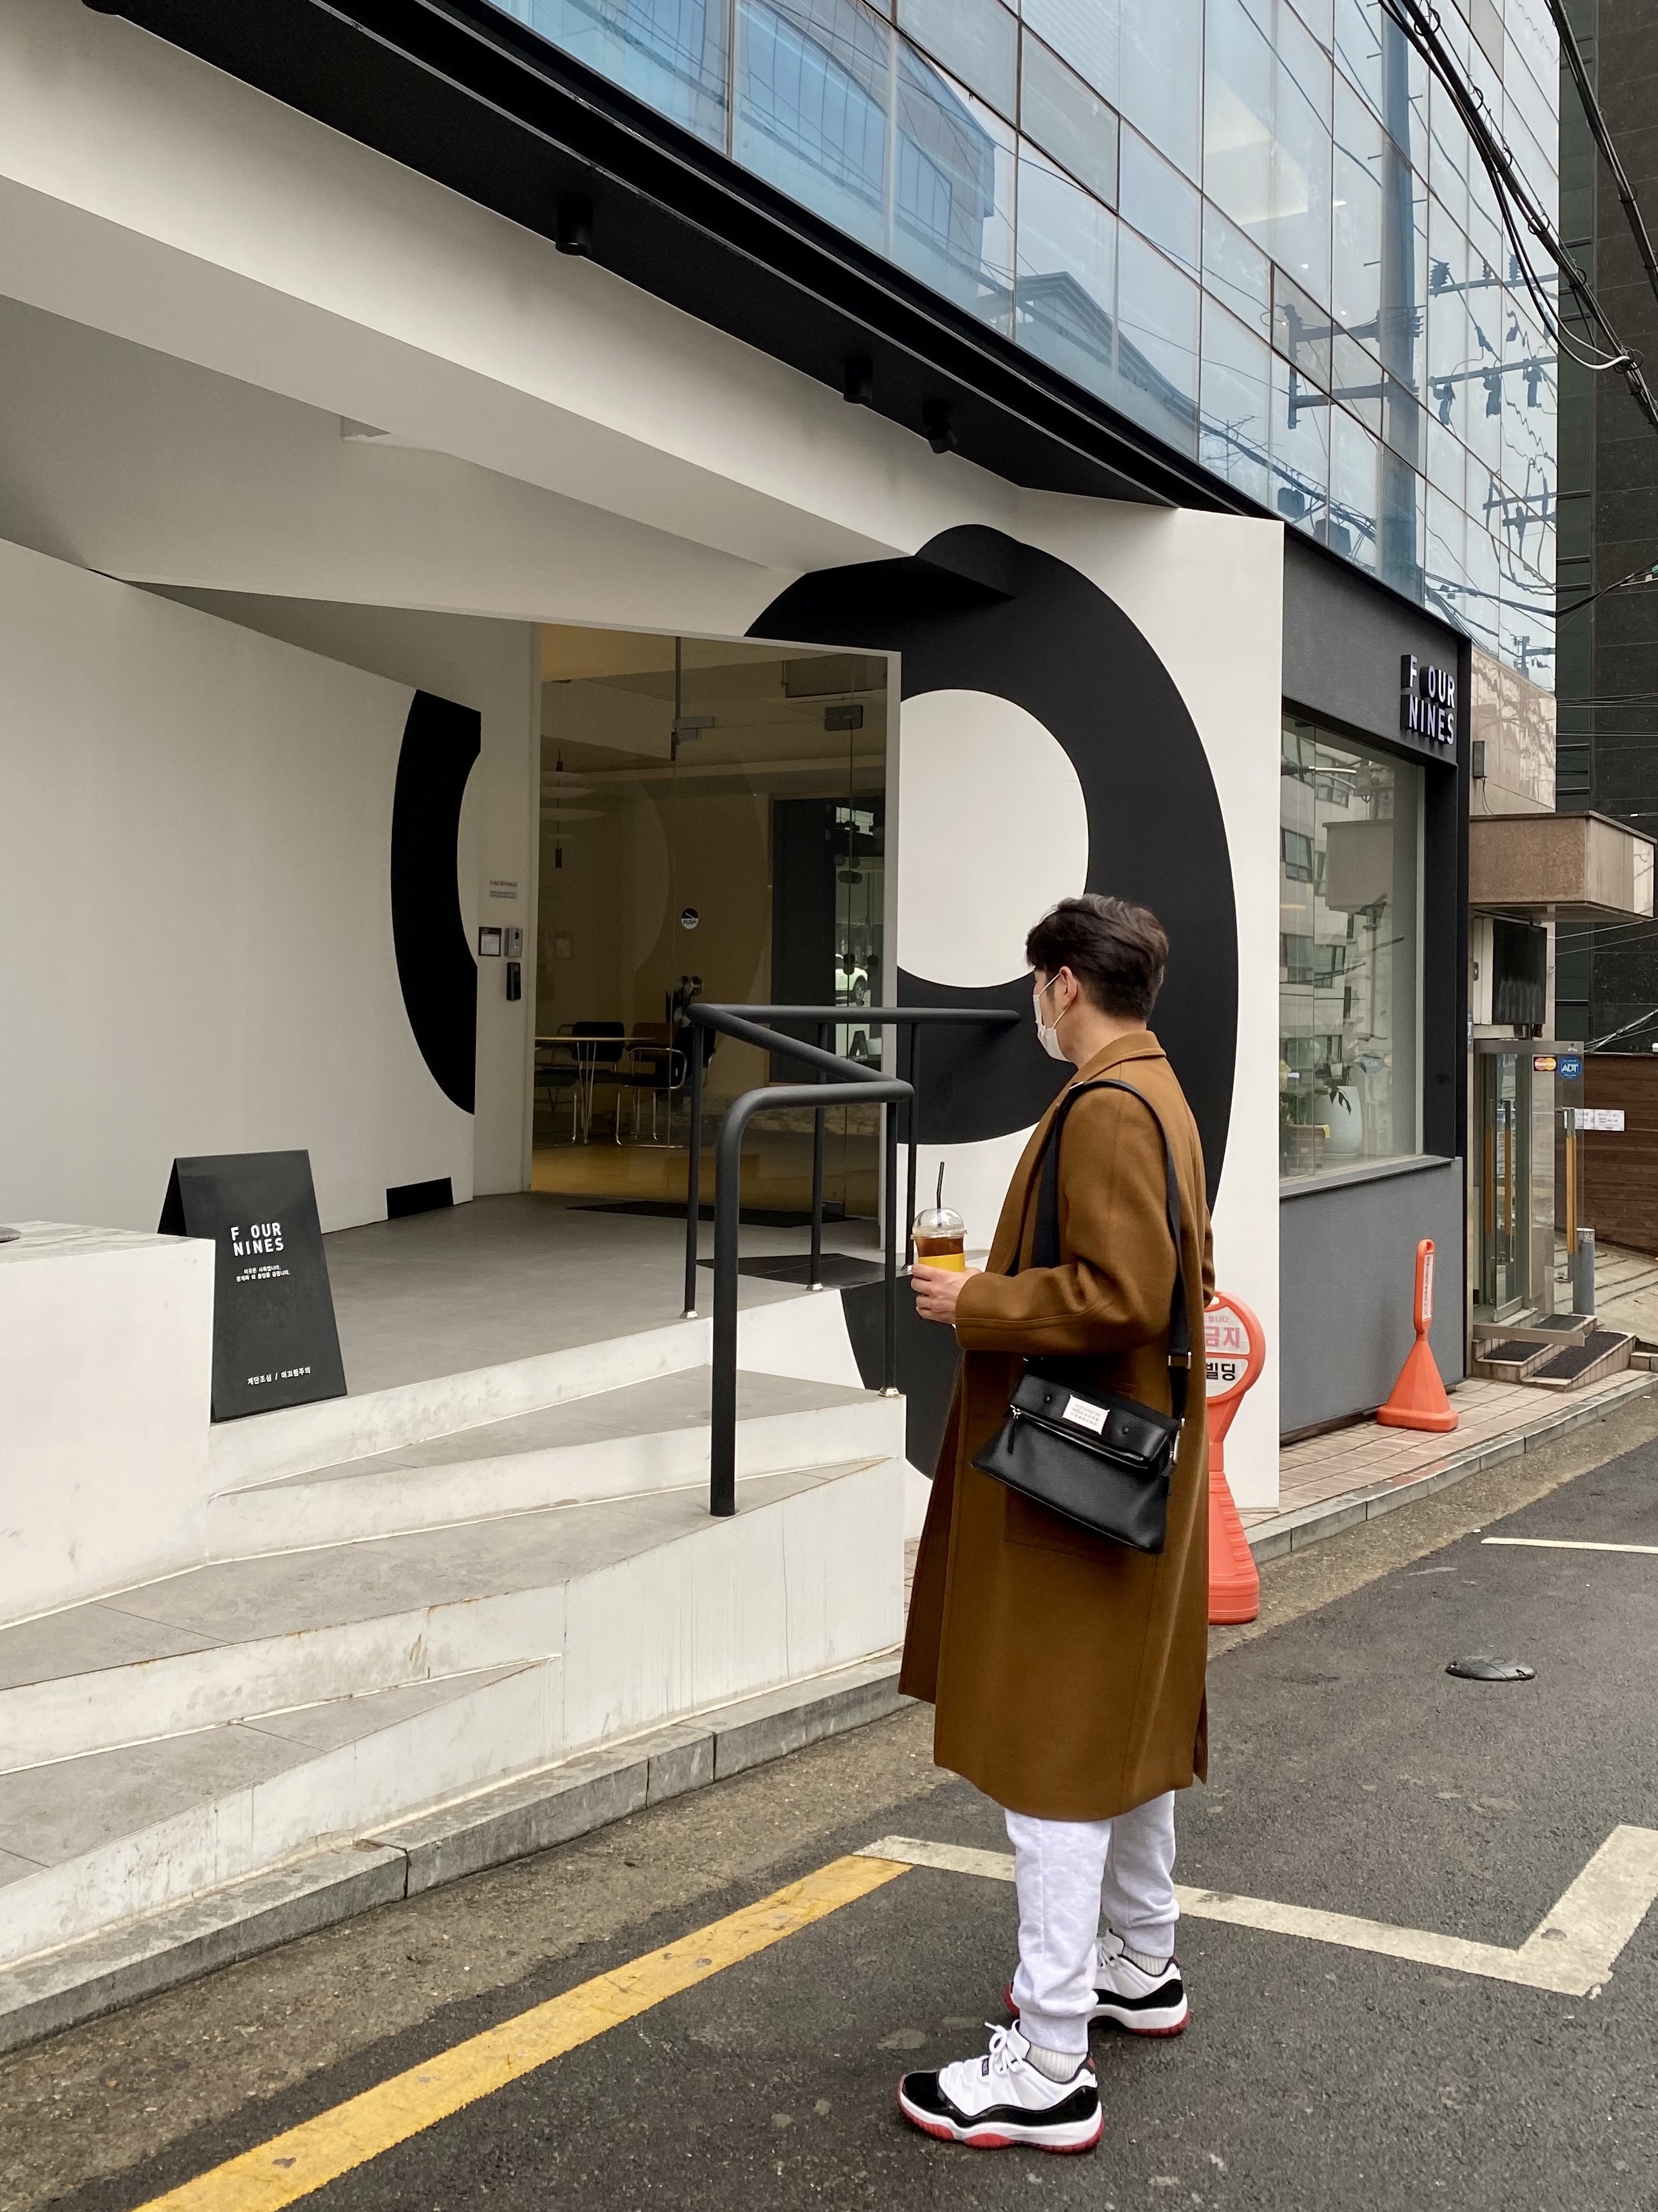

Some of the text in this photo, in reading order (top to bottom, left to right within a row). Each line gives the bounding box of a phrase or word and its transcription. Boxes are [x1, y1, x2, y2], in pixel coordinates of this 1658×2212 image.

[1407, 694, 1455, 745] NINES
[1561, 1063, 1579, 1073] ADT
[233, 1237, 284, 1257] NINES
[247, 1373, 272, 1385] 계단조심
[280, 1366, 311, 1379] 미끄럼주의
